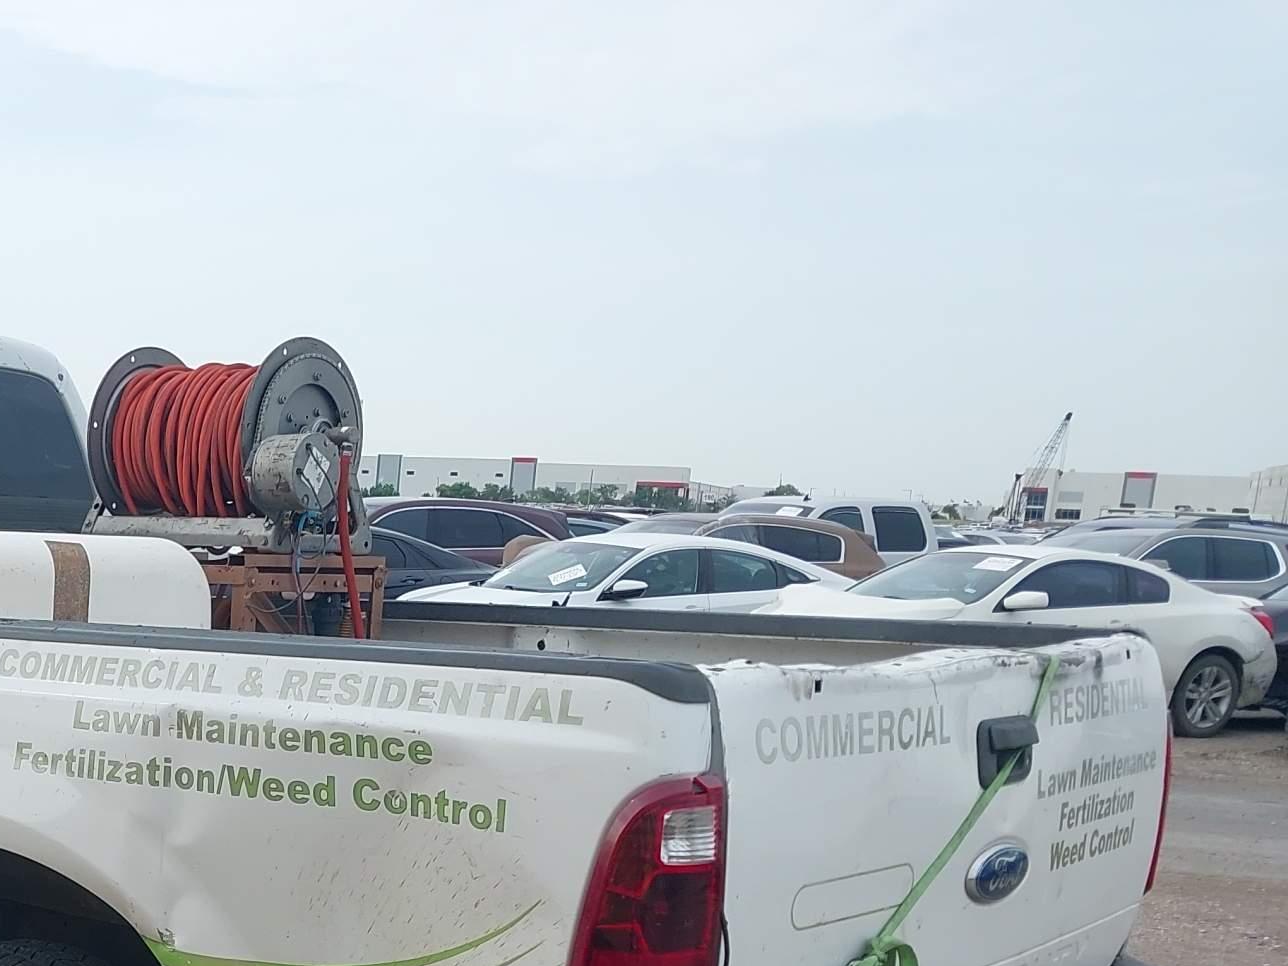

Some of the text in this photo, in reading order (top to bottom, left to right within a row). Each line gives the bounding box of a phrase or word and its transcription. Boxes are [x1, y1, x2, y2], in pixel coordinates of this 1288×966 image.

[237, 666, 263, 698] &
[278, 668, 584, 727] RESIDENTIAL
[1048, 675, 1149, 727] RESIDENTIAL
[72, 699, 433, 765] Lawn Maintenance
[755, 703, 952, 765] COMMERCIAL
[12, 740, 507, 834] Fertilization/Weed Control
[1037, 748, 1158, 800] Lawn Maintenance
[1058, 788, 1135, 832] Fertilization
[1049, 818, 1136, 873] Weed Control
